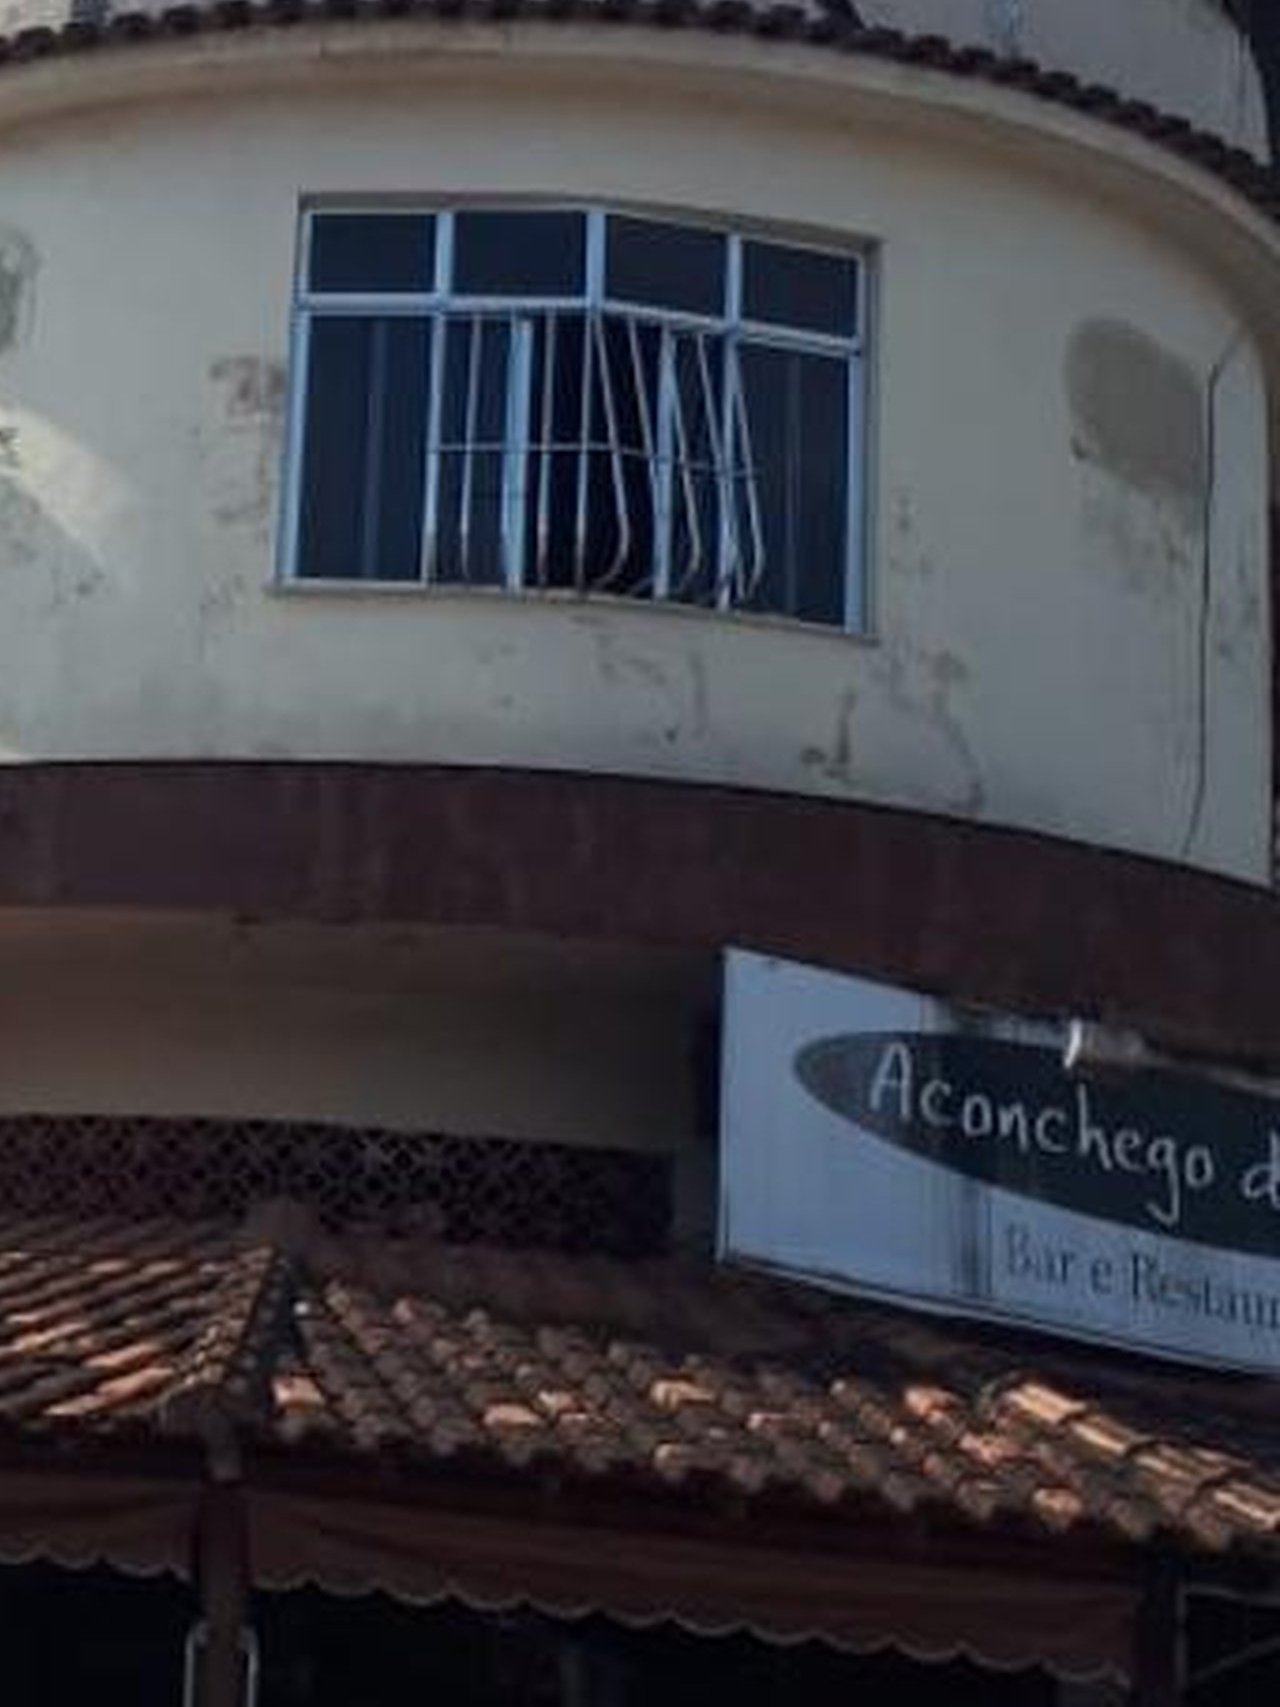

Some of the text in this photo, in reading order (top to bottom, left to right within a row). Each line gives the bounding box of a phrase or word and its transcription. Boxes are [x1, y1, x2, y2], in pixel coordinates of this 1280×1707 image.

[870, 1042, 1214, 1226] Aconchego
[1007, 1224, 1074, 1284] Bar
[1090, 1260, 1113, 1294] e
